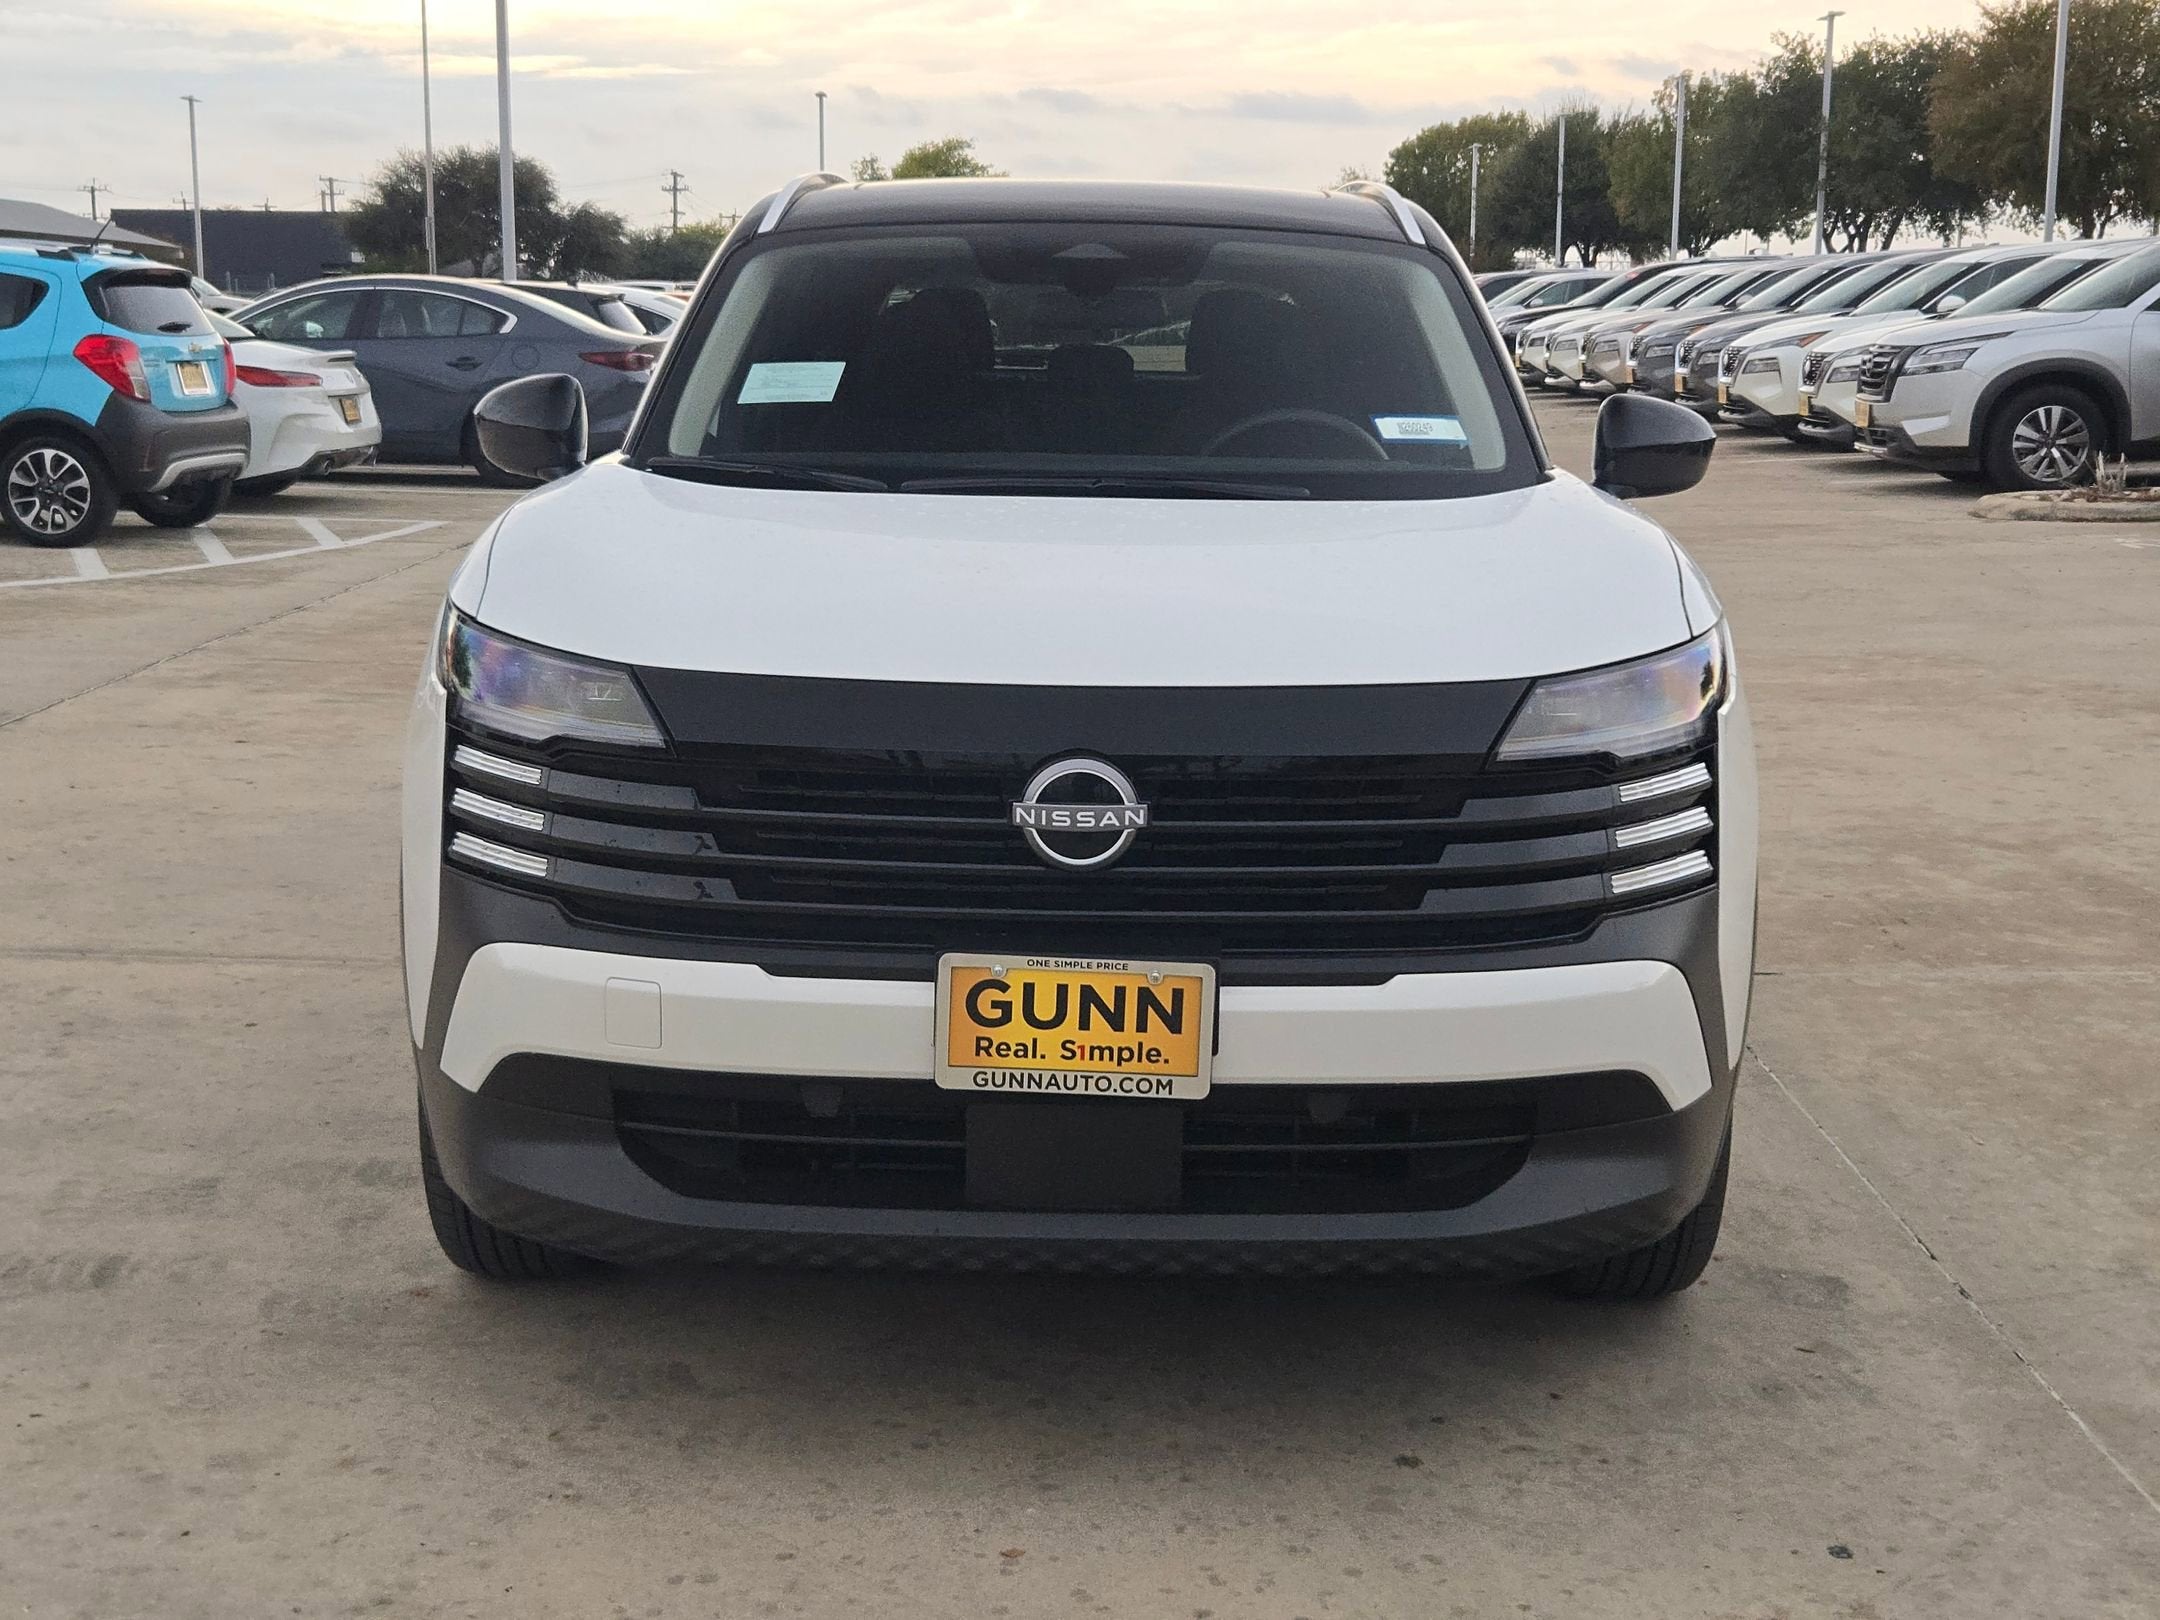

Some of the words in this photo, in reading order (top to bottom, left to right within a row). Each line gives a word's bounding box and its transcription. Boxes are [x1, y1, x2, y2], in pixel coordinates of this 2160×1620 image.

[1015, 807, 1144, 827] NISSAN
[1026, 959, 1051, 968] ONE
[1053, 960, 1093, 970] SIMPLE
[1096, 962, 1129, 971] PRICE
[965, 979, 1185, 1035] GUNN
[974, 1036, 1046, 1060] Real.
[972, 1071, 1174, 1096] GUNNAUTO.COM
